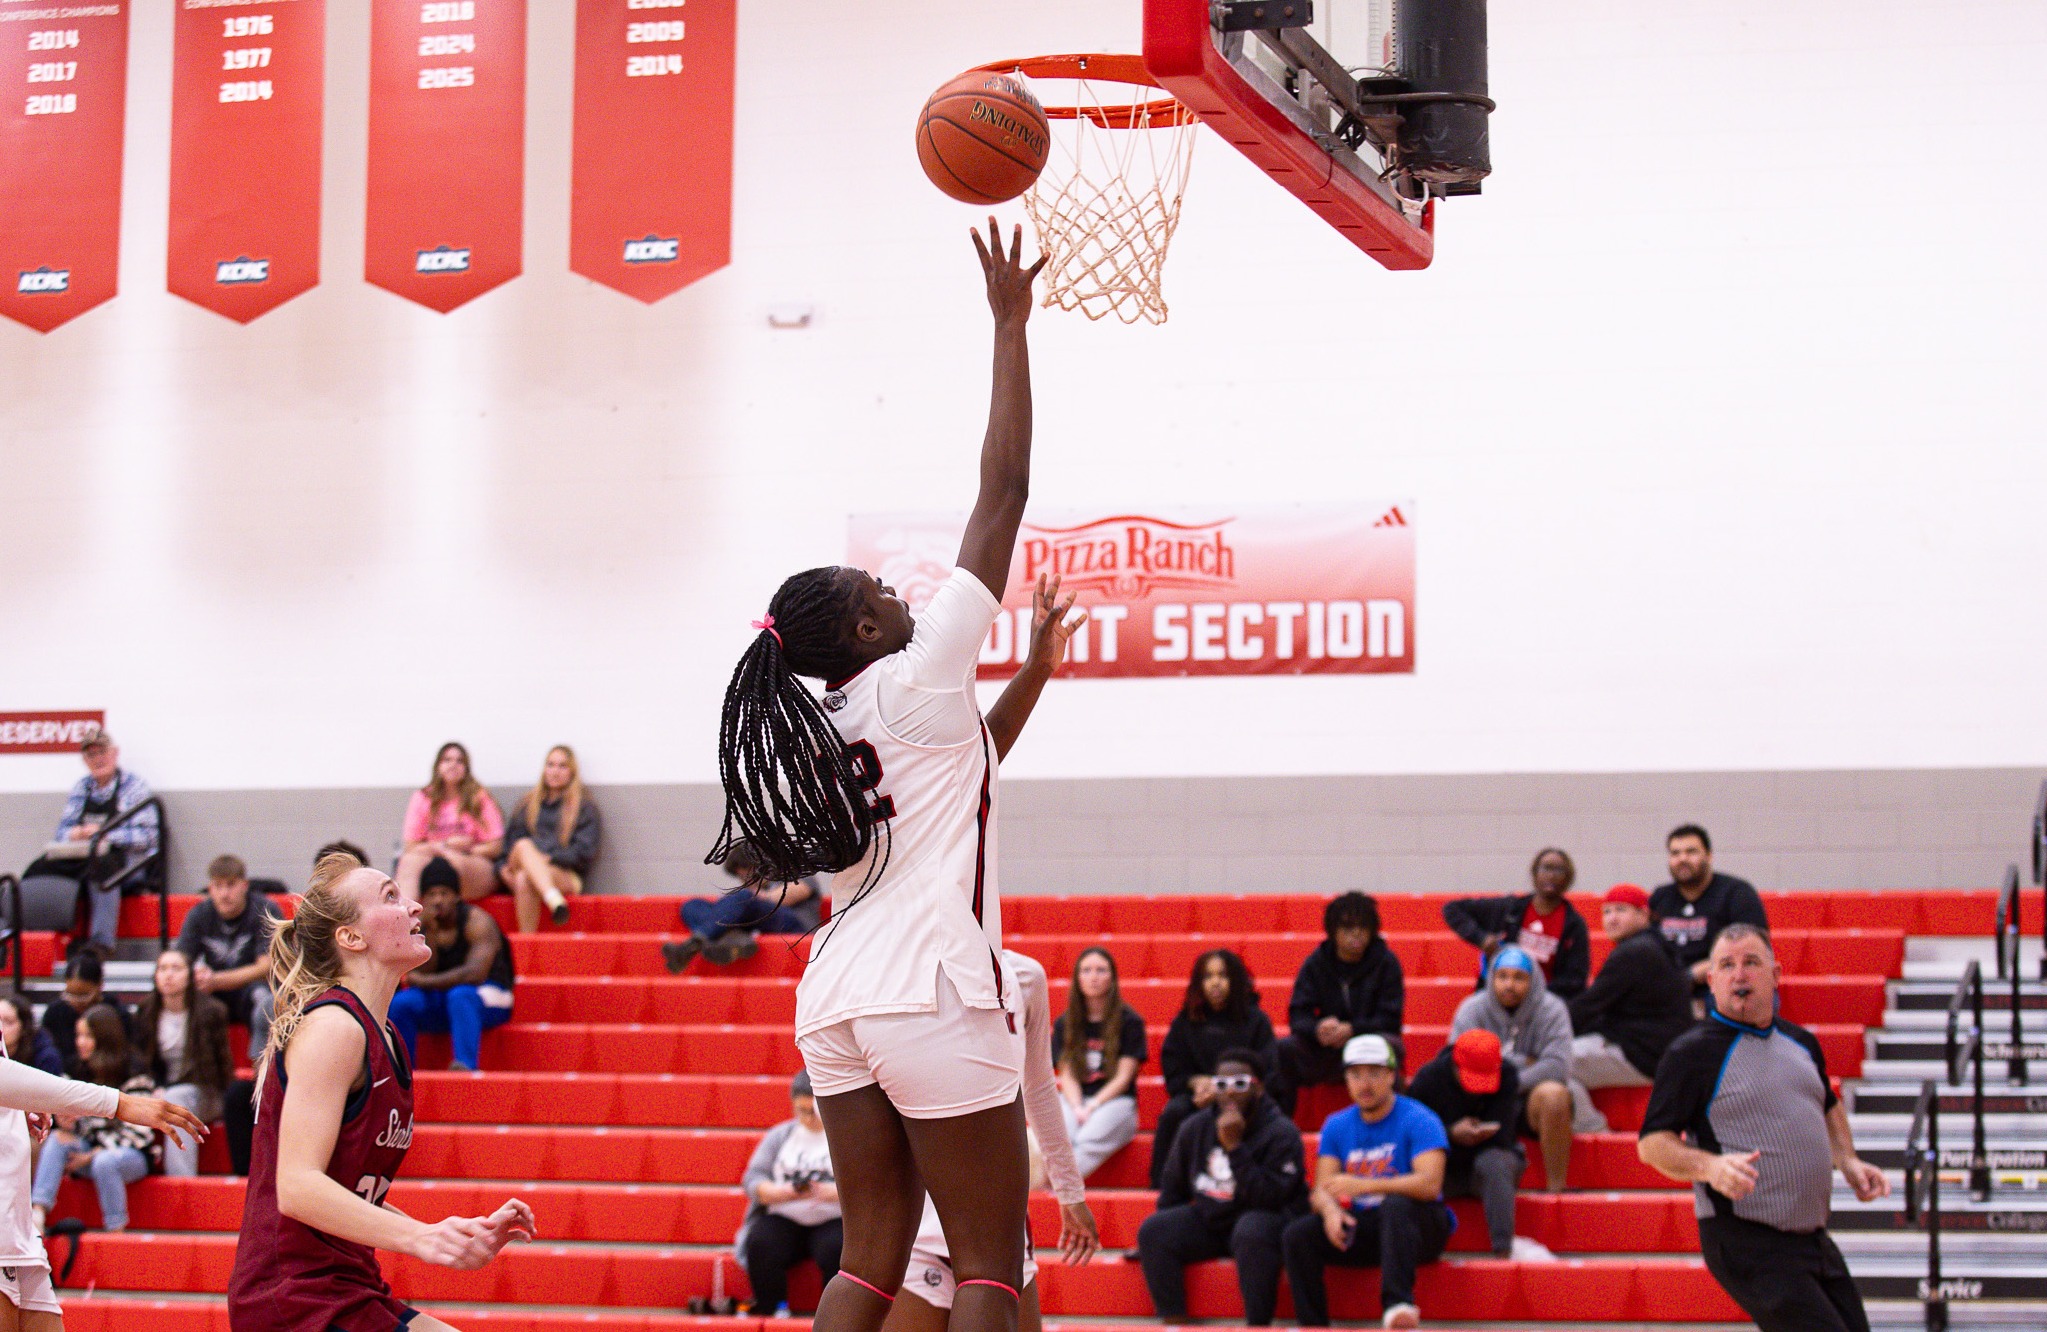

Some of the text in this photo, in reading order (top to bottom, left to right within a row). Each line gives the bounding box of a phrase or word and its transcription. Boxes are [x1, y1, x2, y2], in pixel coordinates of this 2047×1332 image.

[222, 15, 273, 37] 1976
[626, 20, 685, 43] 2009
[28, 29, 80, 51] 2014
[418, 34, 475, 56] 2024
[222, 47, 272, 70] 1977
[626, 54, 683, 77] 2014
[27, 61, 78, 83] 2017
[418, 66, 474, 89] 2025
[218, 80, 273, 103] 2014
[25, 94, 77, 115] 2018
[969, 100, 1045, 157] SPALDING
[1023, 527, 1234, 582] Pizza Ranch
[1152, 600, 1405, 661] SECTION
[1917, 1278, 1983, 1299] Srvice
